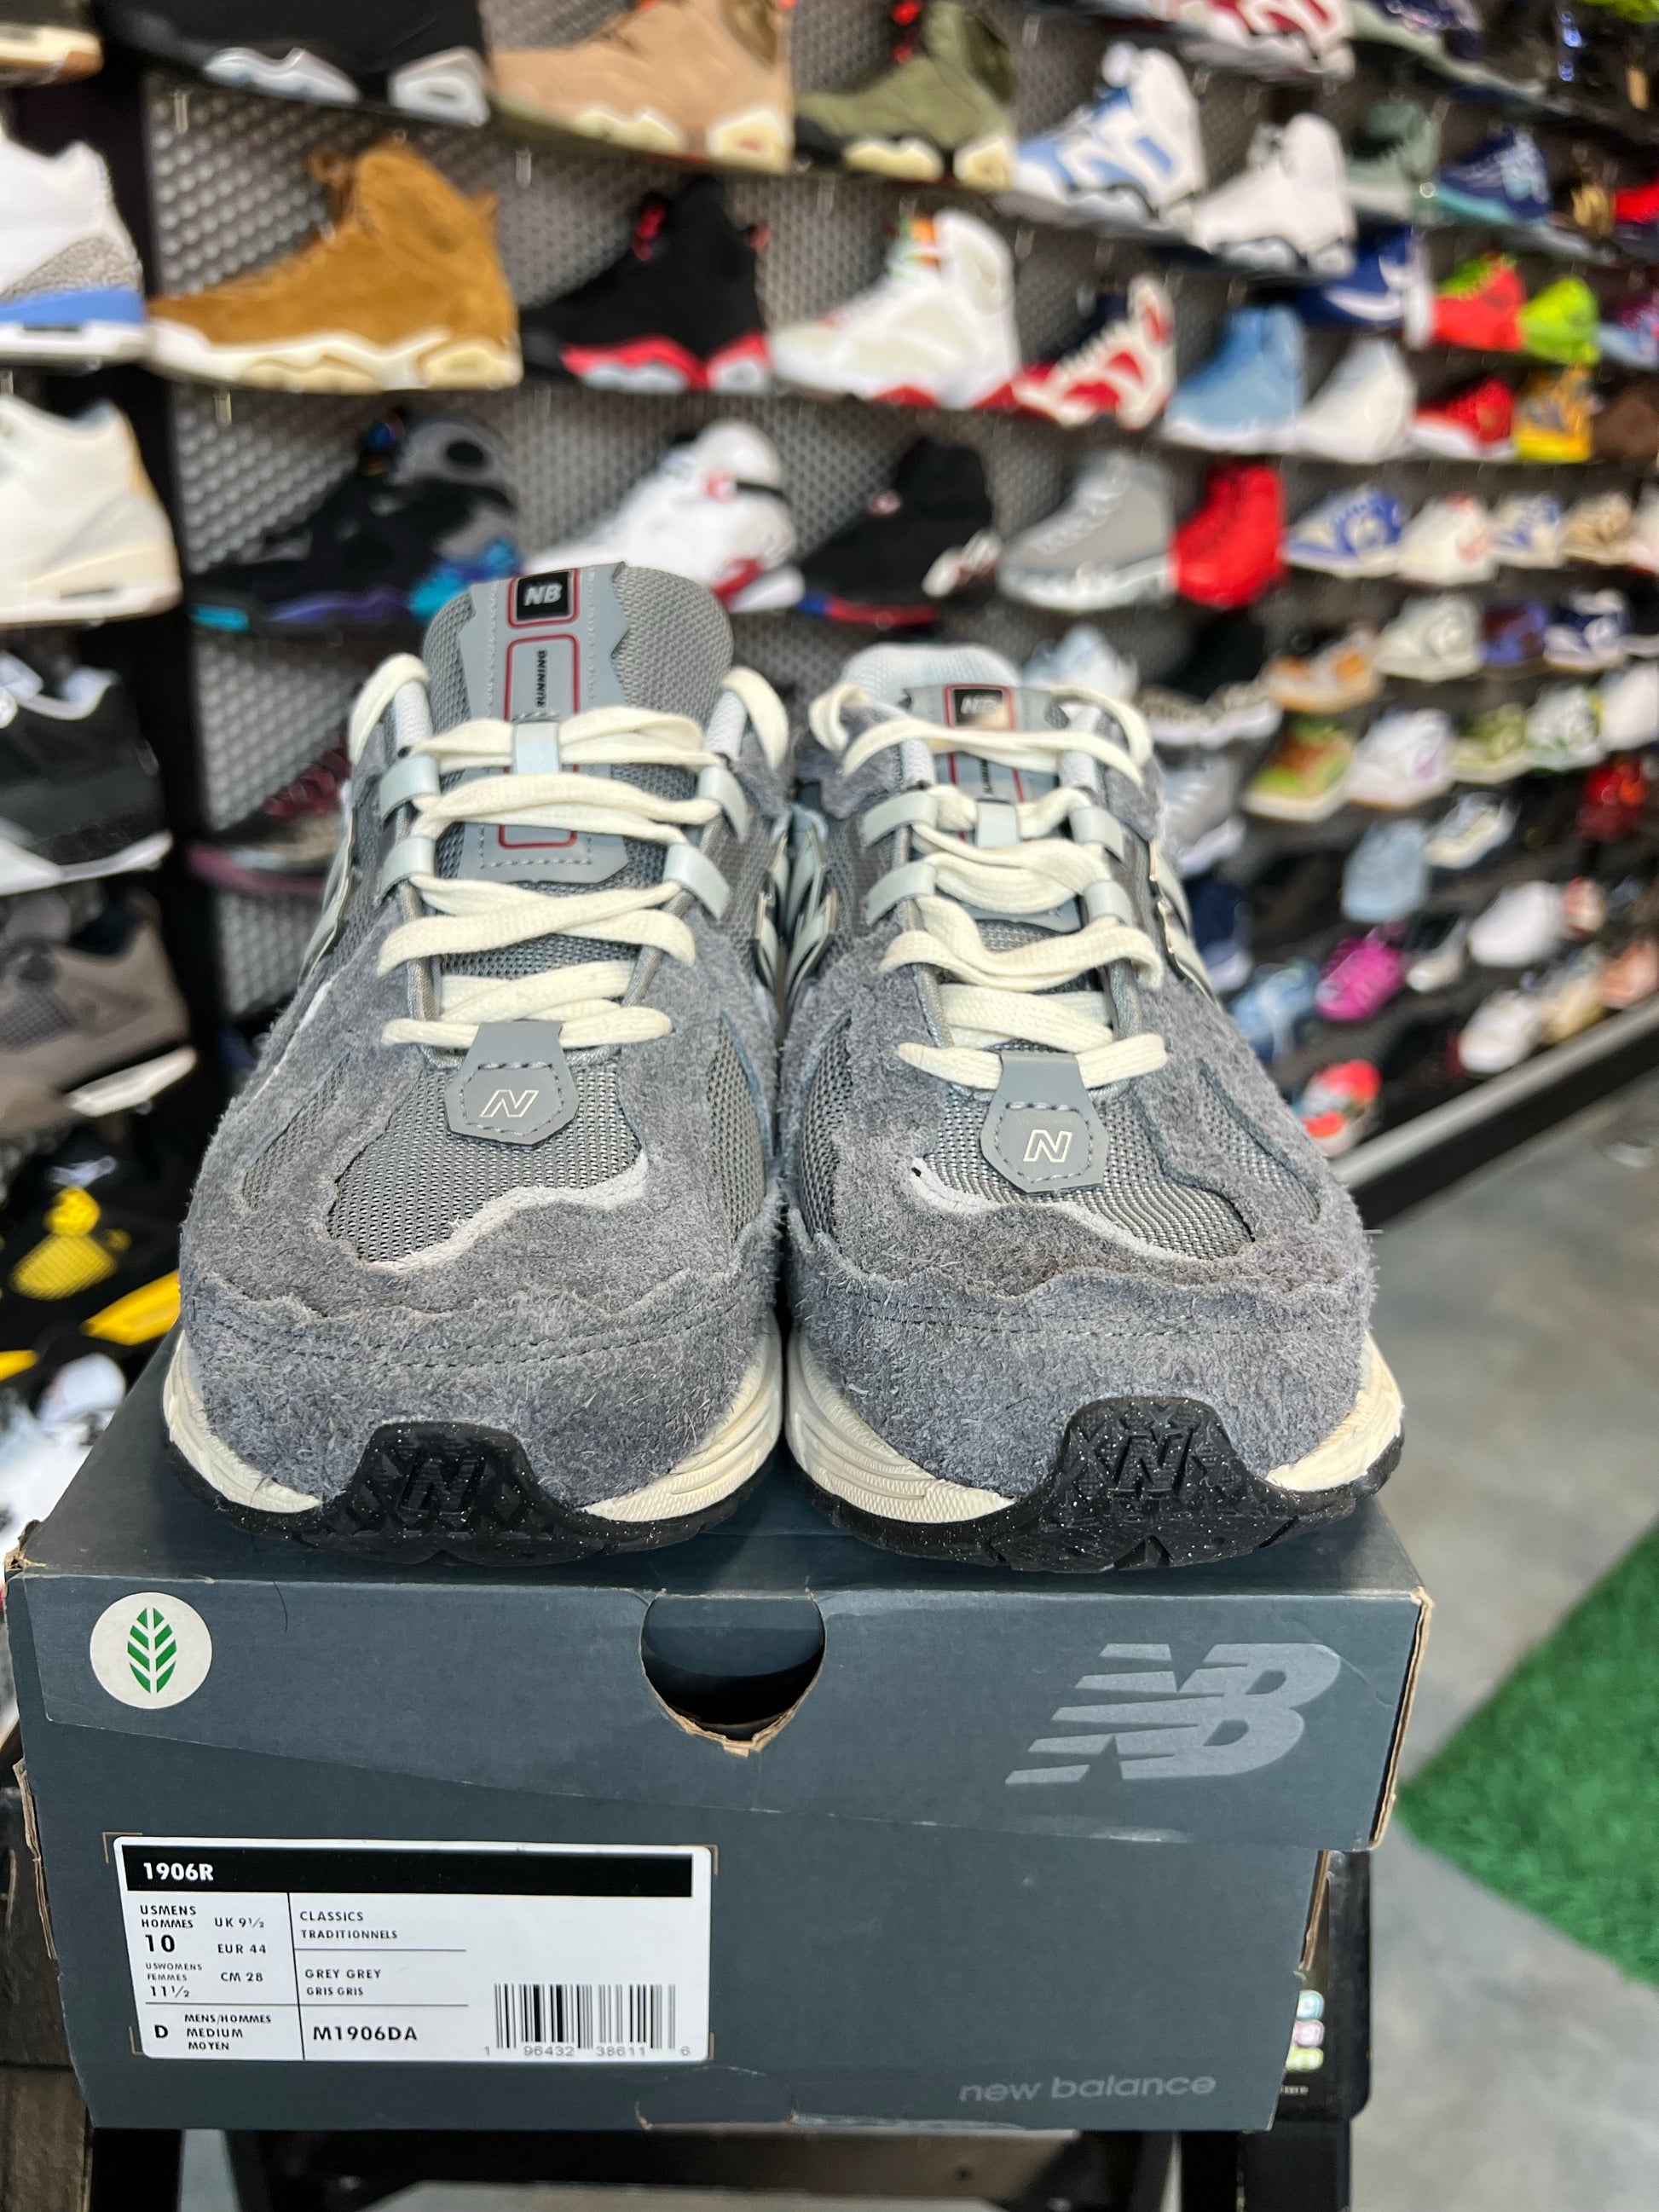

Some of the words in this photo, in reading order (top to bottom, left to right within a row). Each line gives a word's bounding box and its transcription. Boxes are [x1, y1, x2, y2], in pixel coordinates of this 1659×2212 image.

[523, 583, 563, 607] NB
[536, 650, 547, 707] RUNNING
[479, 1089, 540, 1118] N
[1023, 1129, 1073, 1162] N
[143, 1863, 214, 1881] 1906R
[140, 1905, 197, 1916] USMENS
[300, 1911, 364, 1921] CLASSICS
[142, 1919, 194, 1929] HOMMES
[214, 1917, 234, 1928] UK
[301, 1929, 398, 1940] TRADITIONNELS
[145, 1934, 176, 1953] 10
[217, 1943, 244, 1955] EUR
[250, 1943, 267, 1955] 44
[146, 1962, 203, 1972] USWOMENS
[147, 1973, 188, 1982] FEMMES
[221, 1972, 242, 1983] CM
[246, 1972, 263, 1983] 28
[305, 1968, 339, 1979] GREY
[346, 1968, 382, 1979] GREY
[306, 1987, 333, 1996] GRIS
[337, 1987, 363, 1996] GRIS
[184, 2014, 272, 2024] MENS/HOMMES
[154, 2025, 169, 2039] D
[187, 2028, 244, 2039] MEDIUM
[313, 2026, 418, 2042] M1906DA
[188, 2042, 229, 2051] MOYEN
[523, 2046, 575, 2058] 96432
[596, 2046, 646, 2058] 38611
[959, 2082, 1042, 2103] new
[1051, 2075, 1217, 2100] balance
